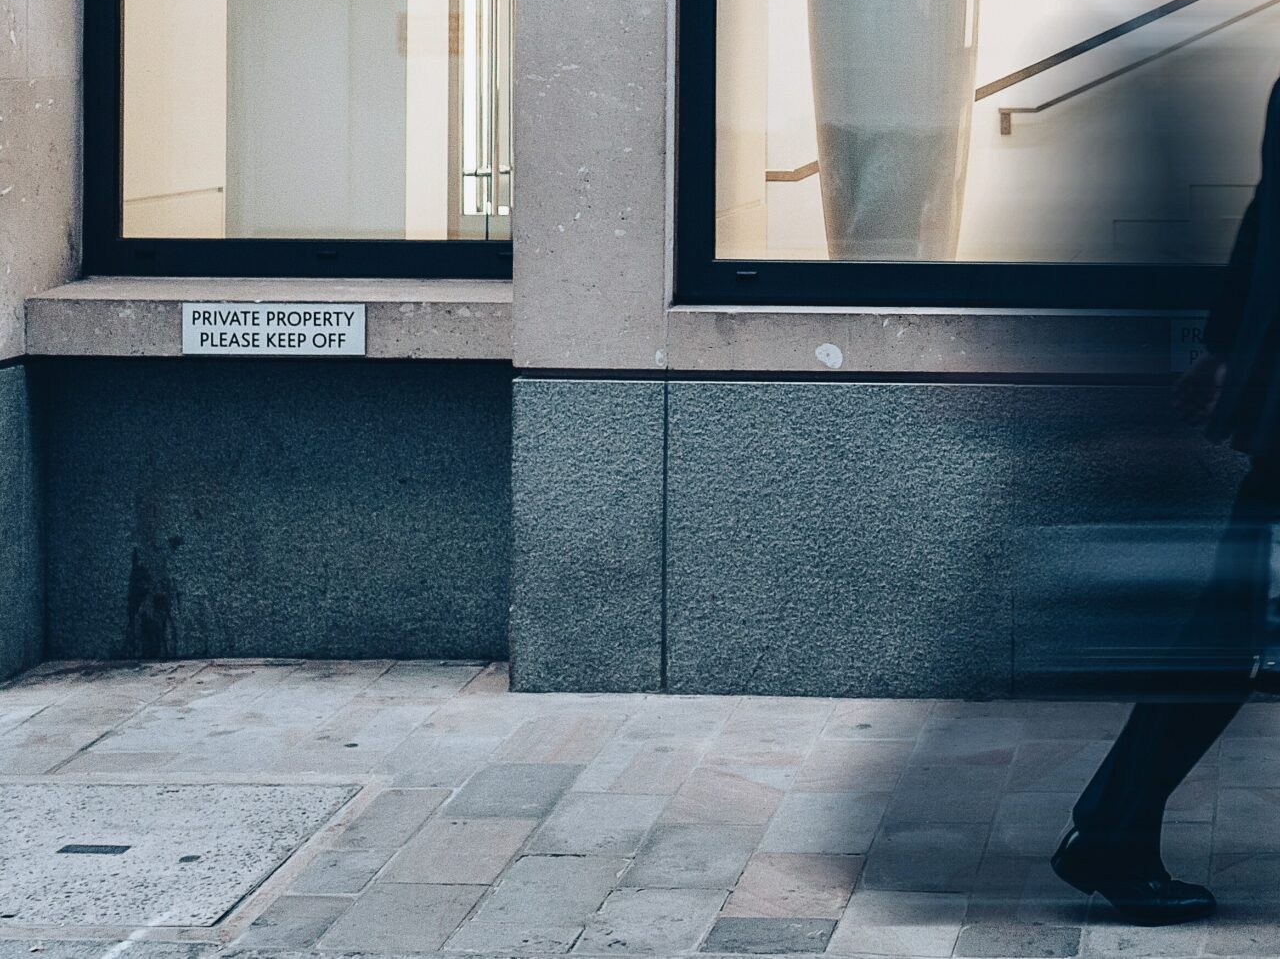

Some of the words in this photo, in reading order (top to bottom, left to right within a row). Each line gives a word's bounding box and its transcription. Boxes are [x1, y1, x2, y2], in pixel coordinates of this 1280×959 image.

[192, 310, 260, 326] PRIVATE
[266, 311, 355, 327] PROPERTY
[200, 332, 260, 348] PLEASE
[266, 333, 306, 348] KEEP
[312, 333, 346, 348] OFF
